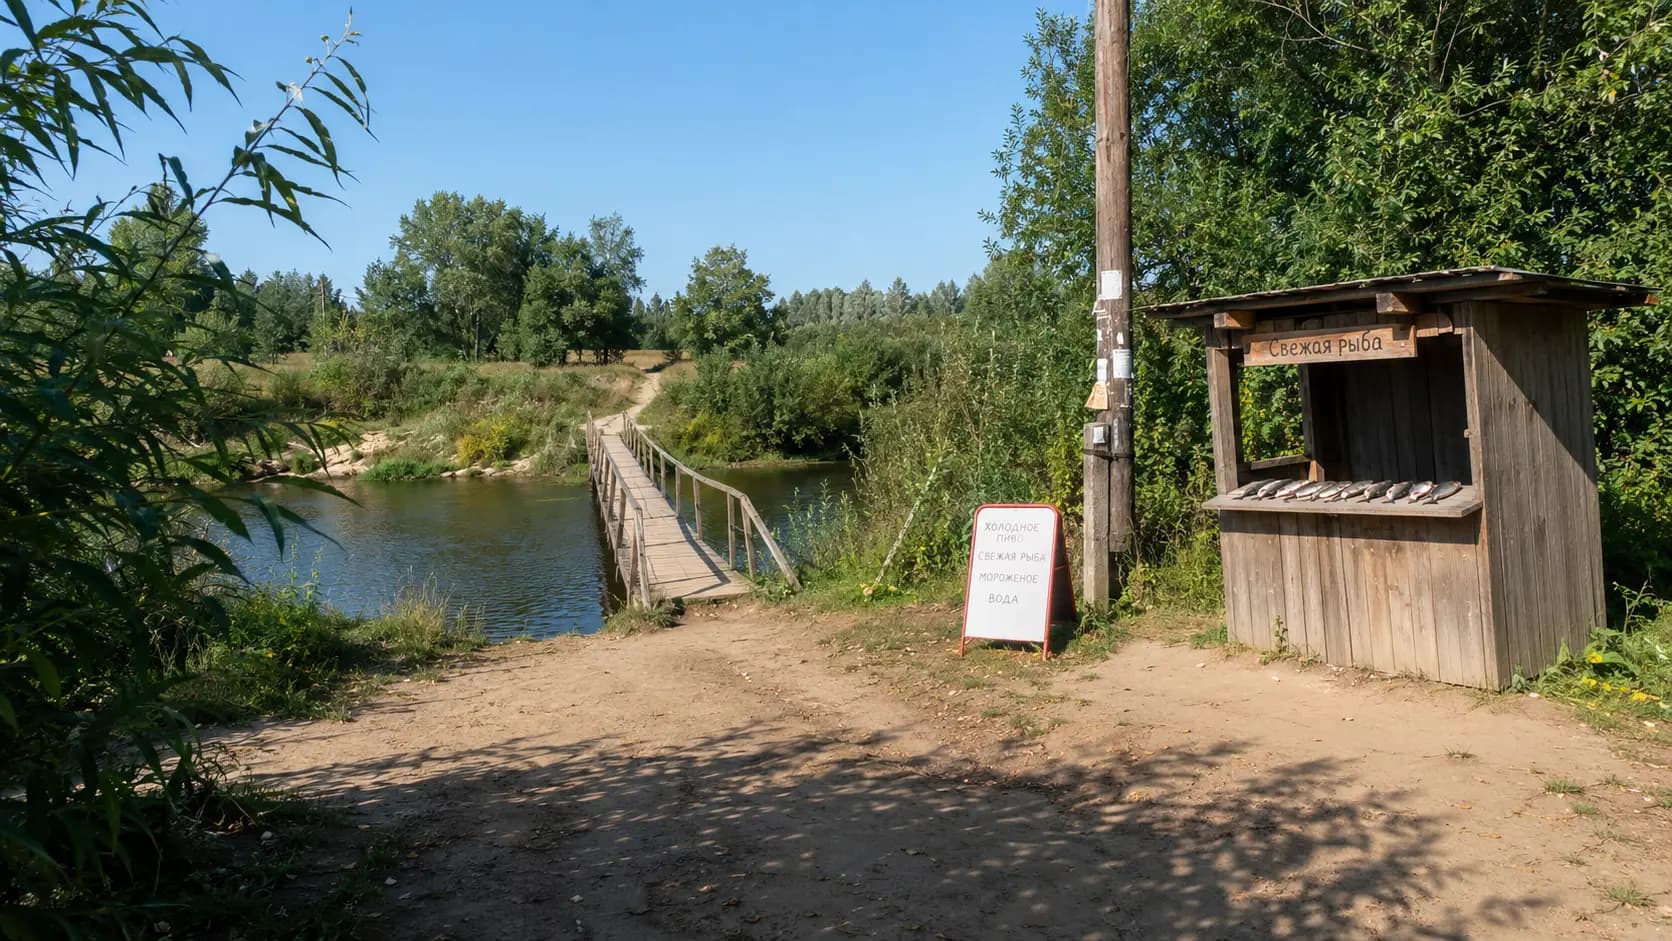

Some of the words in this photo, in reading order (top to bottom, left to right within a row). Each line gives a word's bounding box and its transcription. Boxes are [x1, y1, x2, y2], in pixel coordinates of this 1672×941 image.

[1269, 338, 1332, 357] Свежая
[1338, 330, 1383, 356] рыба
[984, 522, 1040, 533] ХОЛОДНОЕ
[978, 551, 1017, 561] СВЕЖАЯ
[1020, 552, 1047, 562] РЫБА
[979, 572, 1039, 584] МОРОЖЕНОЕ
[988, 592, 1018, 605] ВОДА
